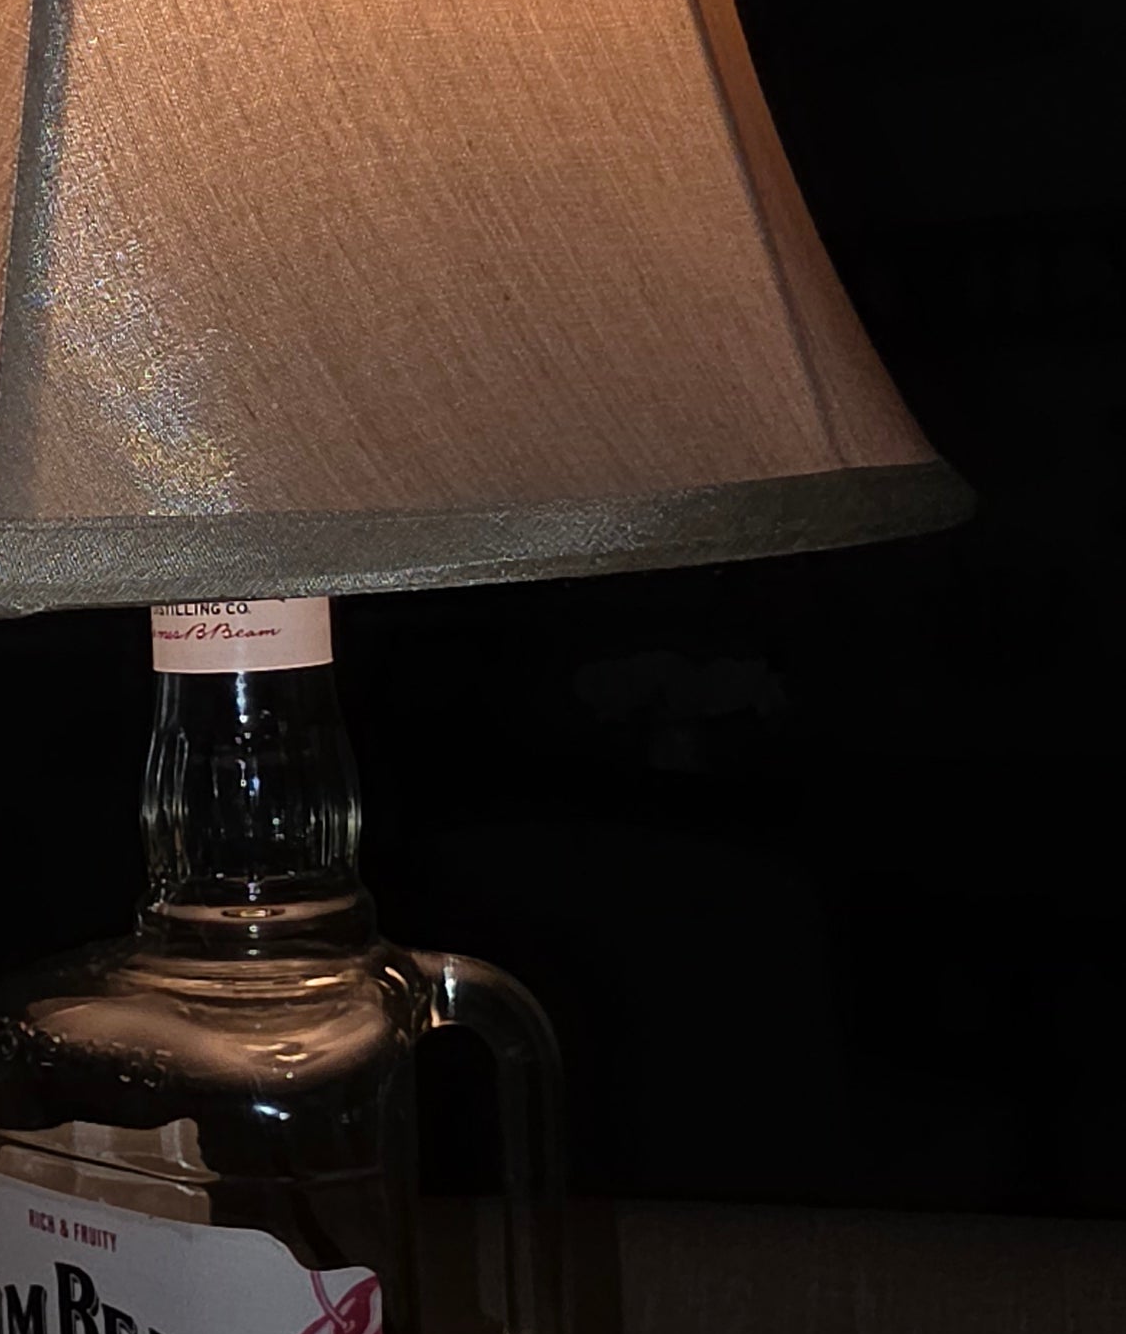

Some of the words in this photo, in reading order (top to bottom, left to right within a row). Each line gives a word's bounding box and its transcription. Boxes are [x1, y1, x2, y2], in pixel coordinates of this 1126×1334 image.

[28, 1208, 56, 1234] RICH
[59, 1218, 69, 1239] &
[73, 1222, 117, 1253] FRUITY
